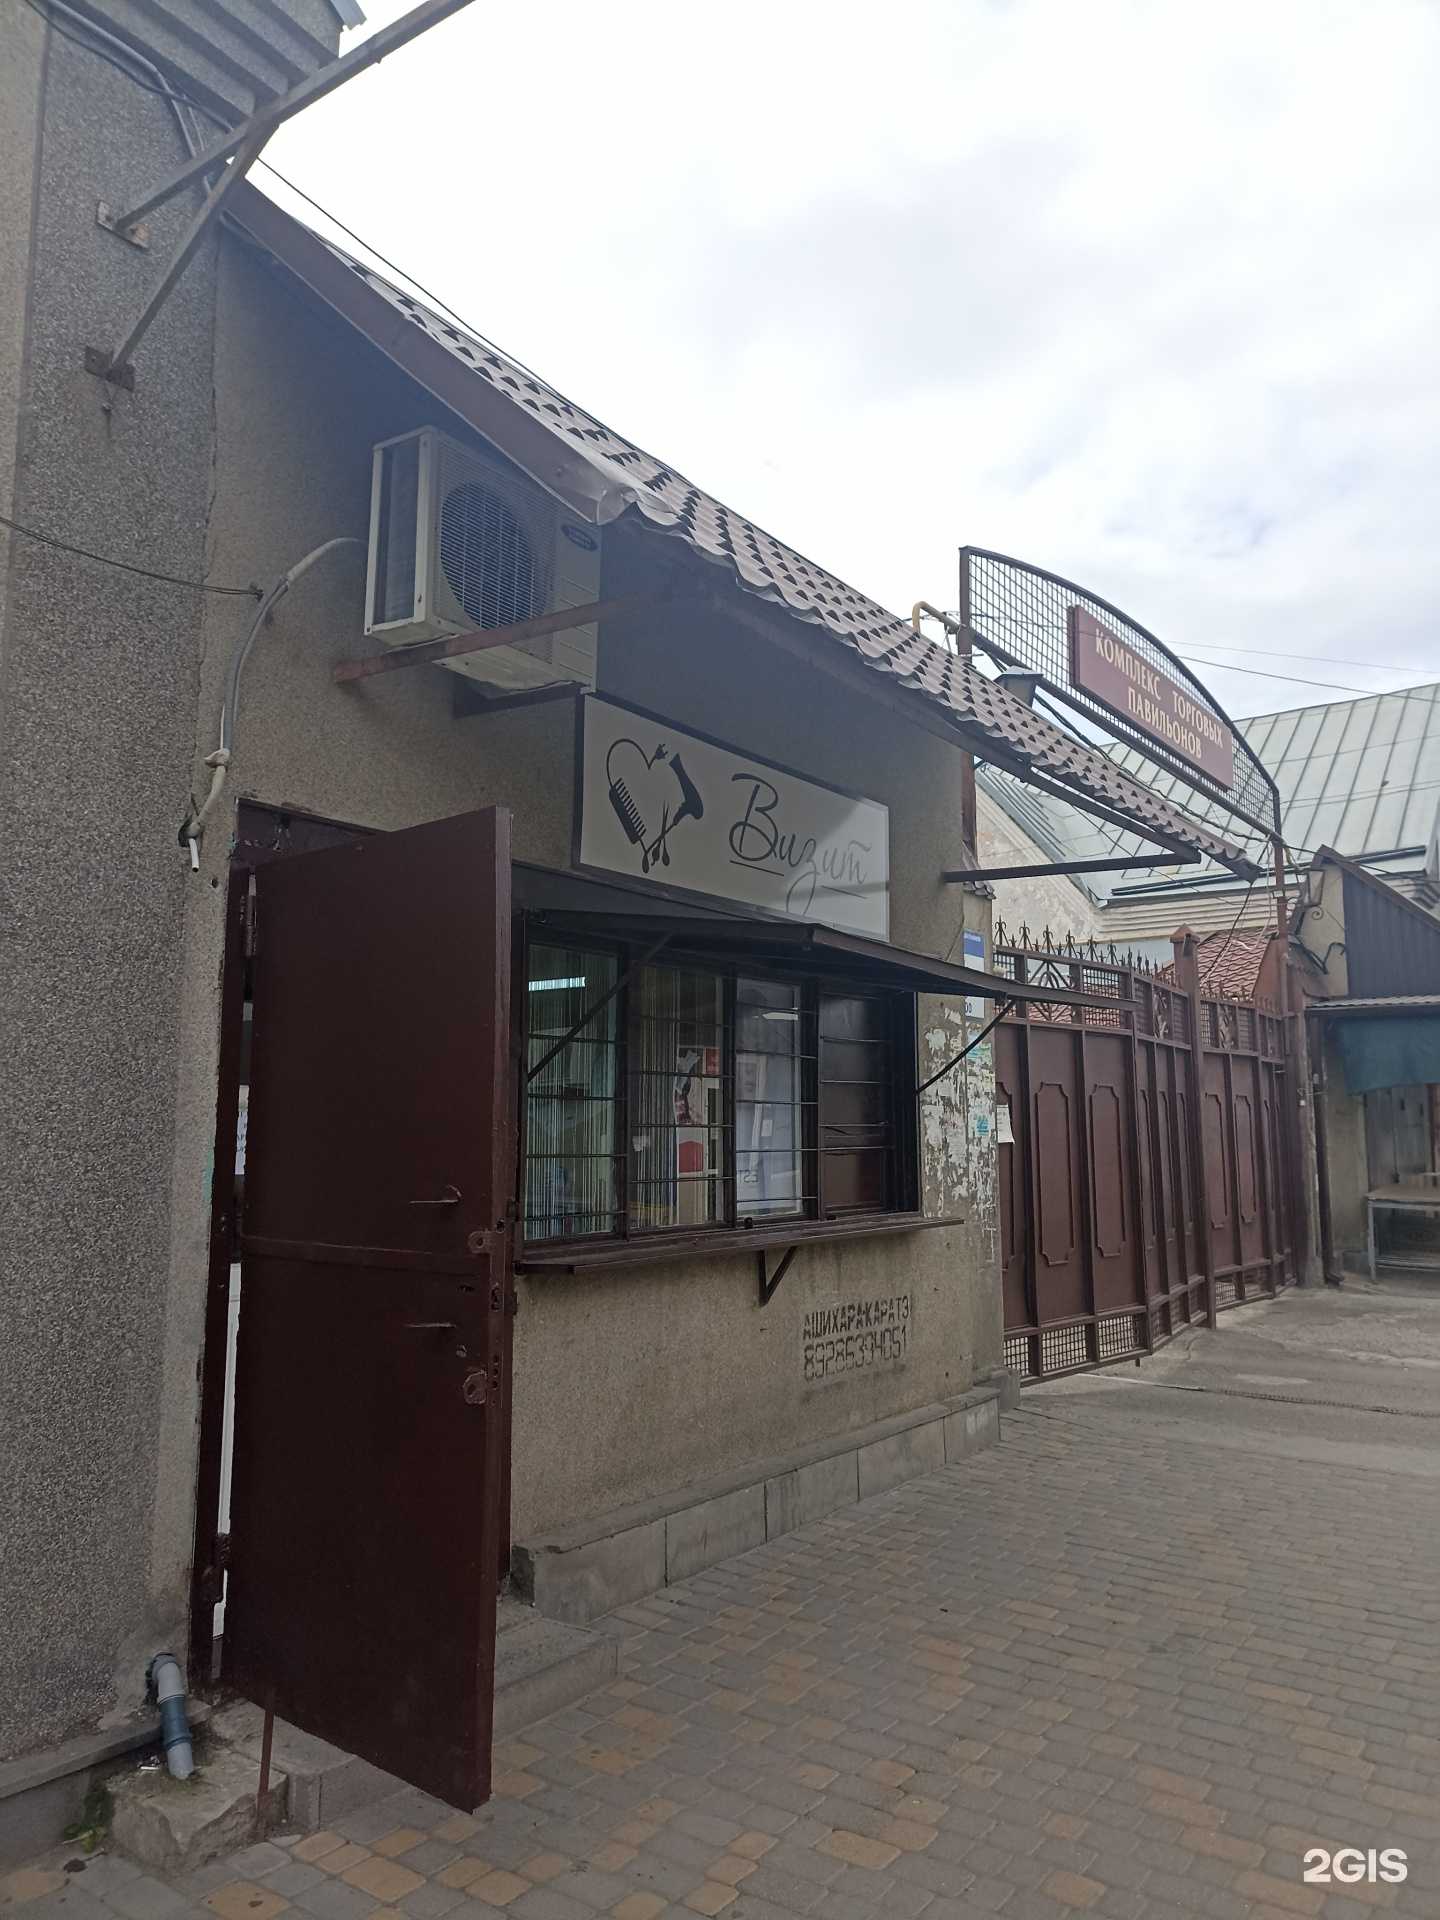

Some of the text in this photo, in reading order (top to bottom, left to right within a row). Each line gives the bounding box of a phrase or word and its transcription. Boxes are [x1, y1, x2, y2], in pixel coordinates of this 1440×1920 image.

[1095, 628, 1223, 748] КОМПЛЕКС ТОРГОВЫХ
[1128, 687, 1202, 758] ПАВИЛЬОНОВ
